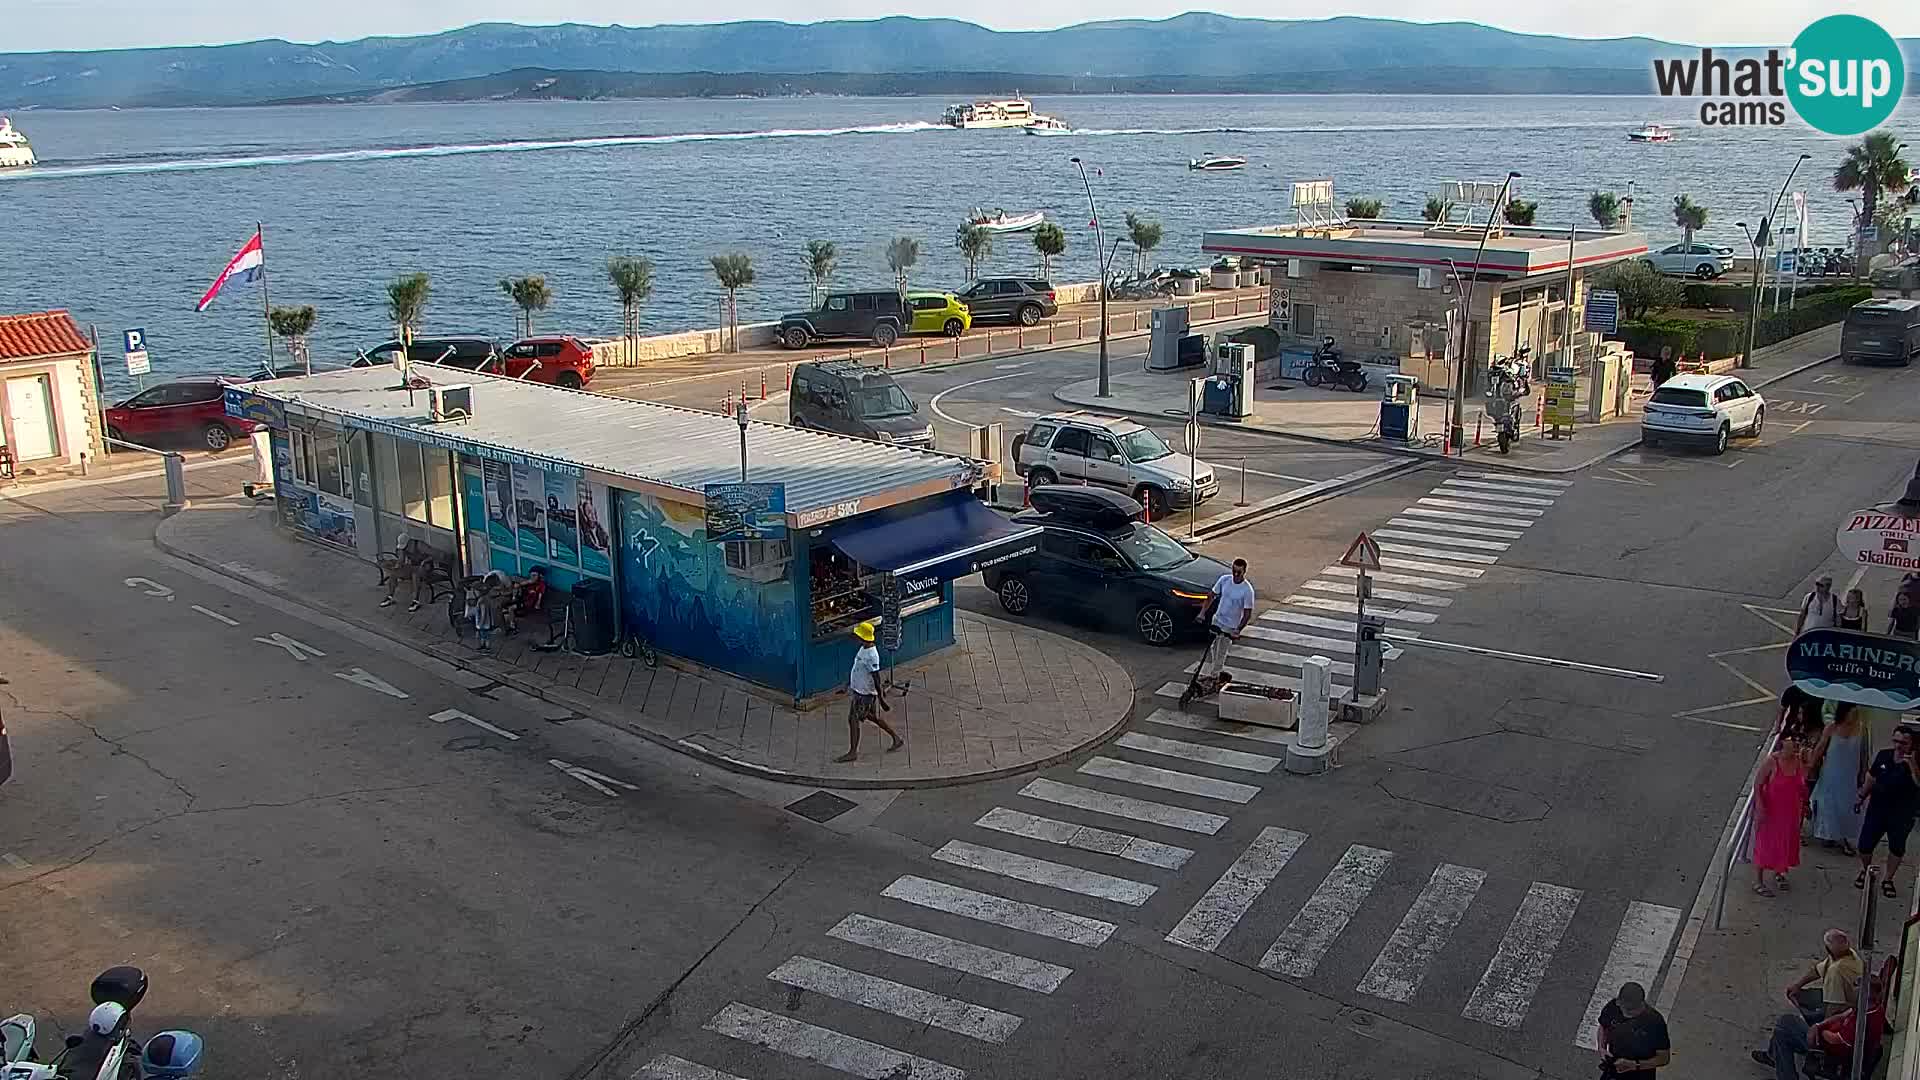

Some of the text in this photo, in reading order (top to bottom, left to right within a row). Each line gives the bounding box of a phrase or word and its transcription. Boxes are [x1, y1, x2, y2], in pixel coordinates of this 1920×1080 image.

[127, 331, 142, 350] P
[434, 437, 466, 452] POSTAJA
[476, 446, 491, 458] BUS
[492, 450, 525, 465] STATION
[527, 457, 553, 472] TICKET
[554, 463, 581, 477] OFFICE
[1827, 662, 1896, 680] caffe bar
